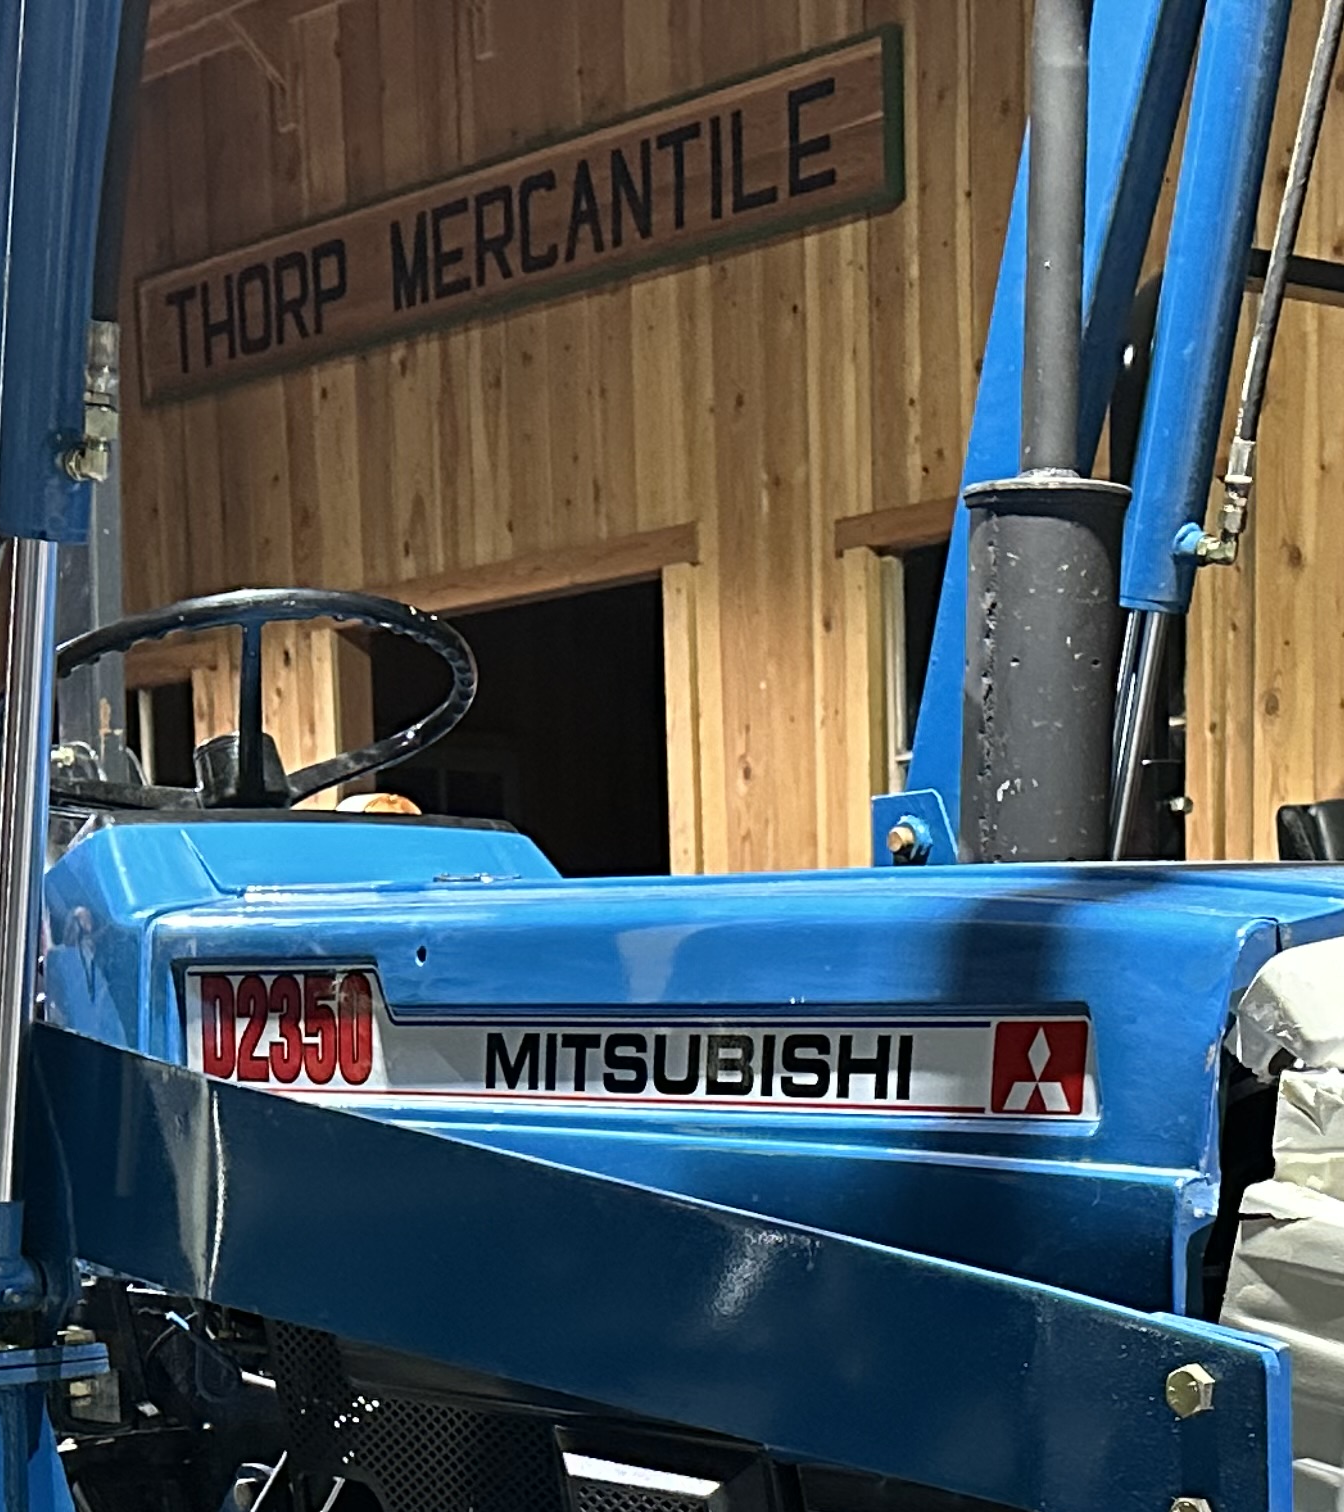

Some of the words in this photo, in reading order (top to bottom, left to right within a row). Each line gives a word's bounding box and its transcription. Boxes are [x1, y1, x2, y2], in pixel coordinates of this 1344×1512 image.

[165, 238, 347, 374] THORP
[389, 77, 837, 312] MERCANTILE
[200, 971, 374, 1086] D2350
[484, 1032, 914, 1101] MITSUBISHI
